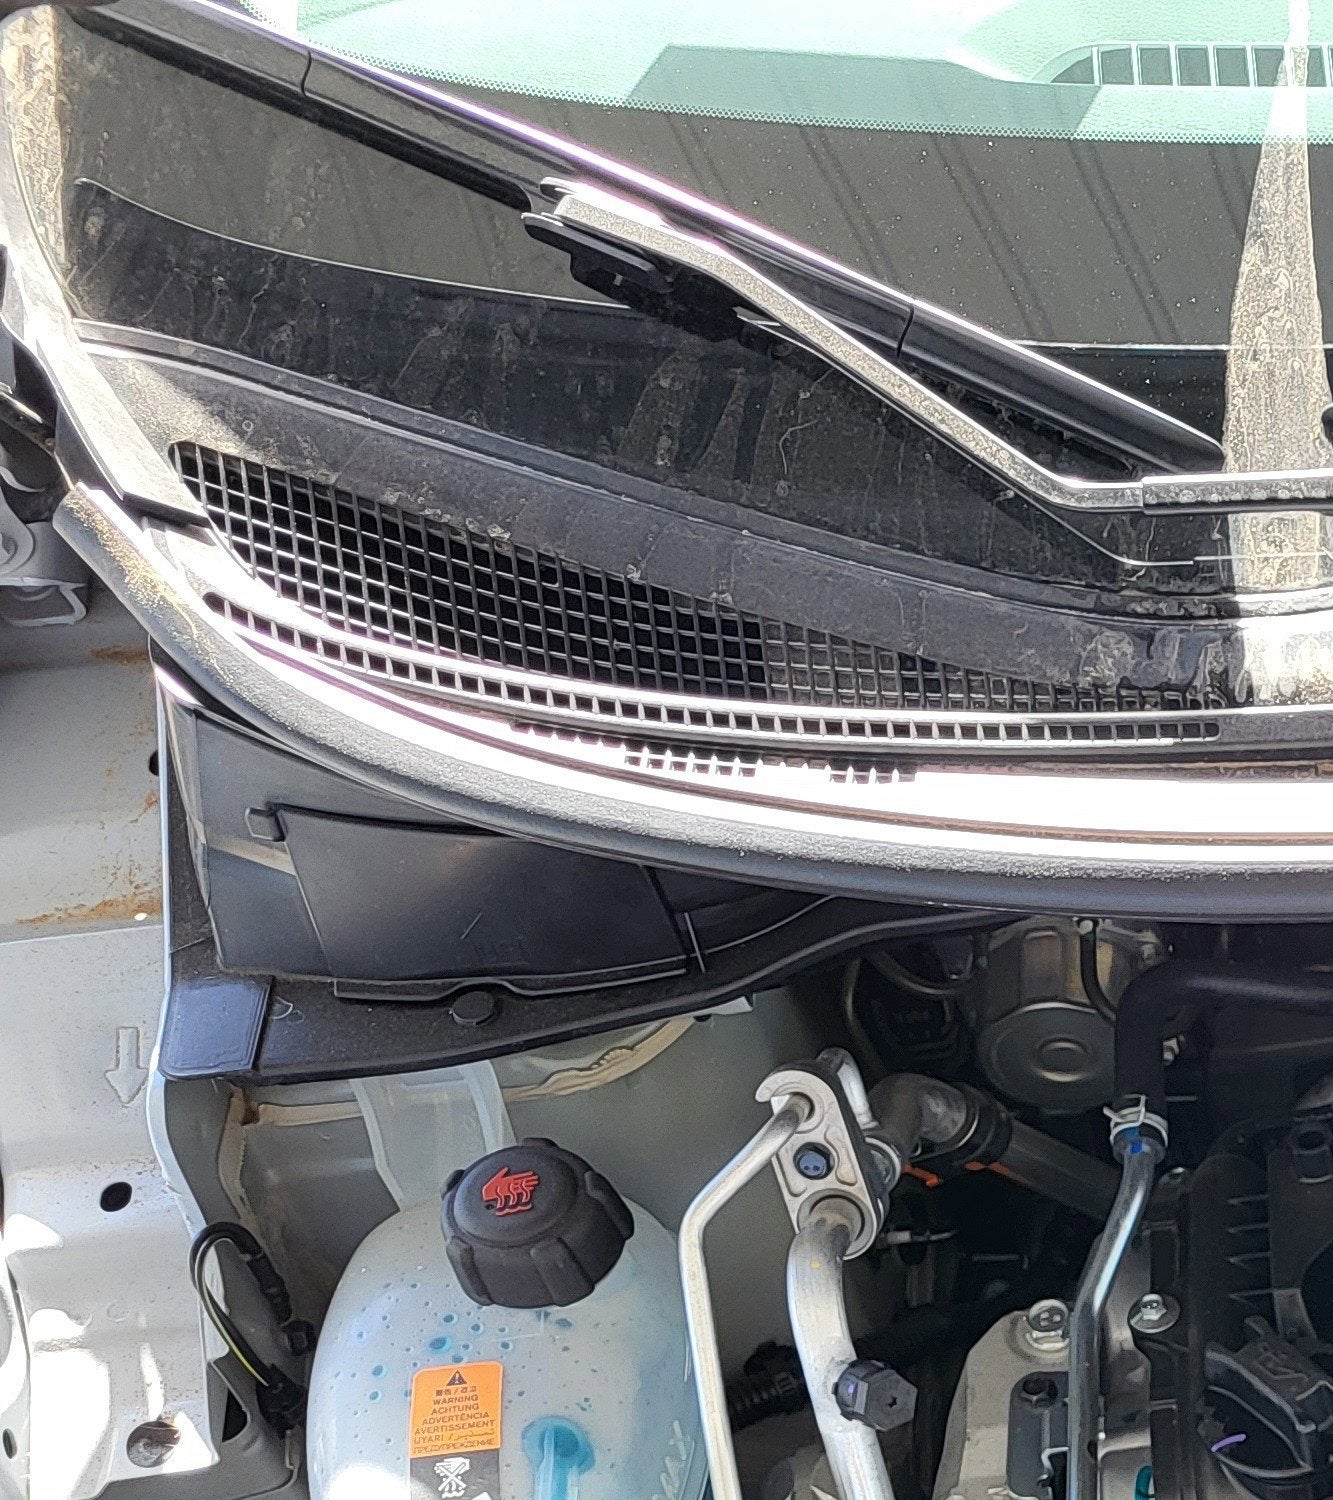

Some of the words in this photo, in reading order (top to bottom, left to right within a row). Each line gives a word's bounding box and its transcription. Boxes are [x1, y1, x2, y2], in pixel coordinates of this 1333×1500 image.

[432, 1394, 479, 1406] WARNING
[431, 1403, 480, 1416] ACHTUNG
[414, 1420, 496, 1436] AVERTISSEMENT
